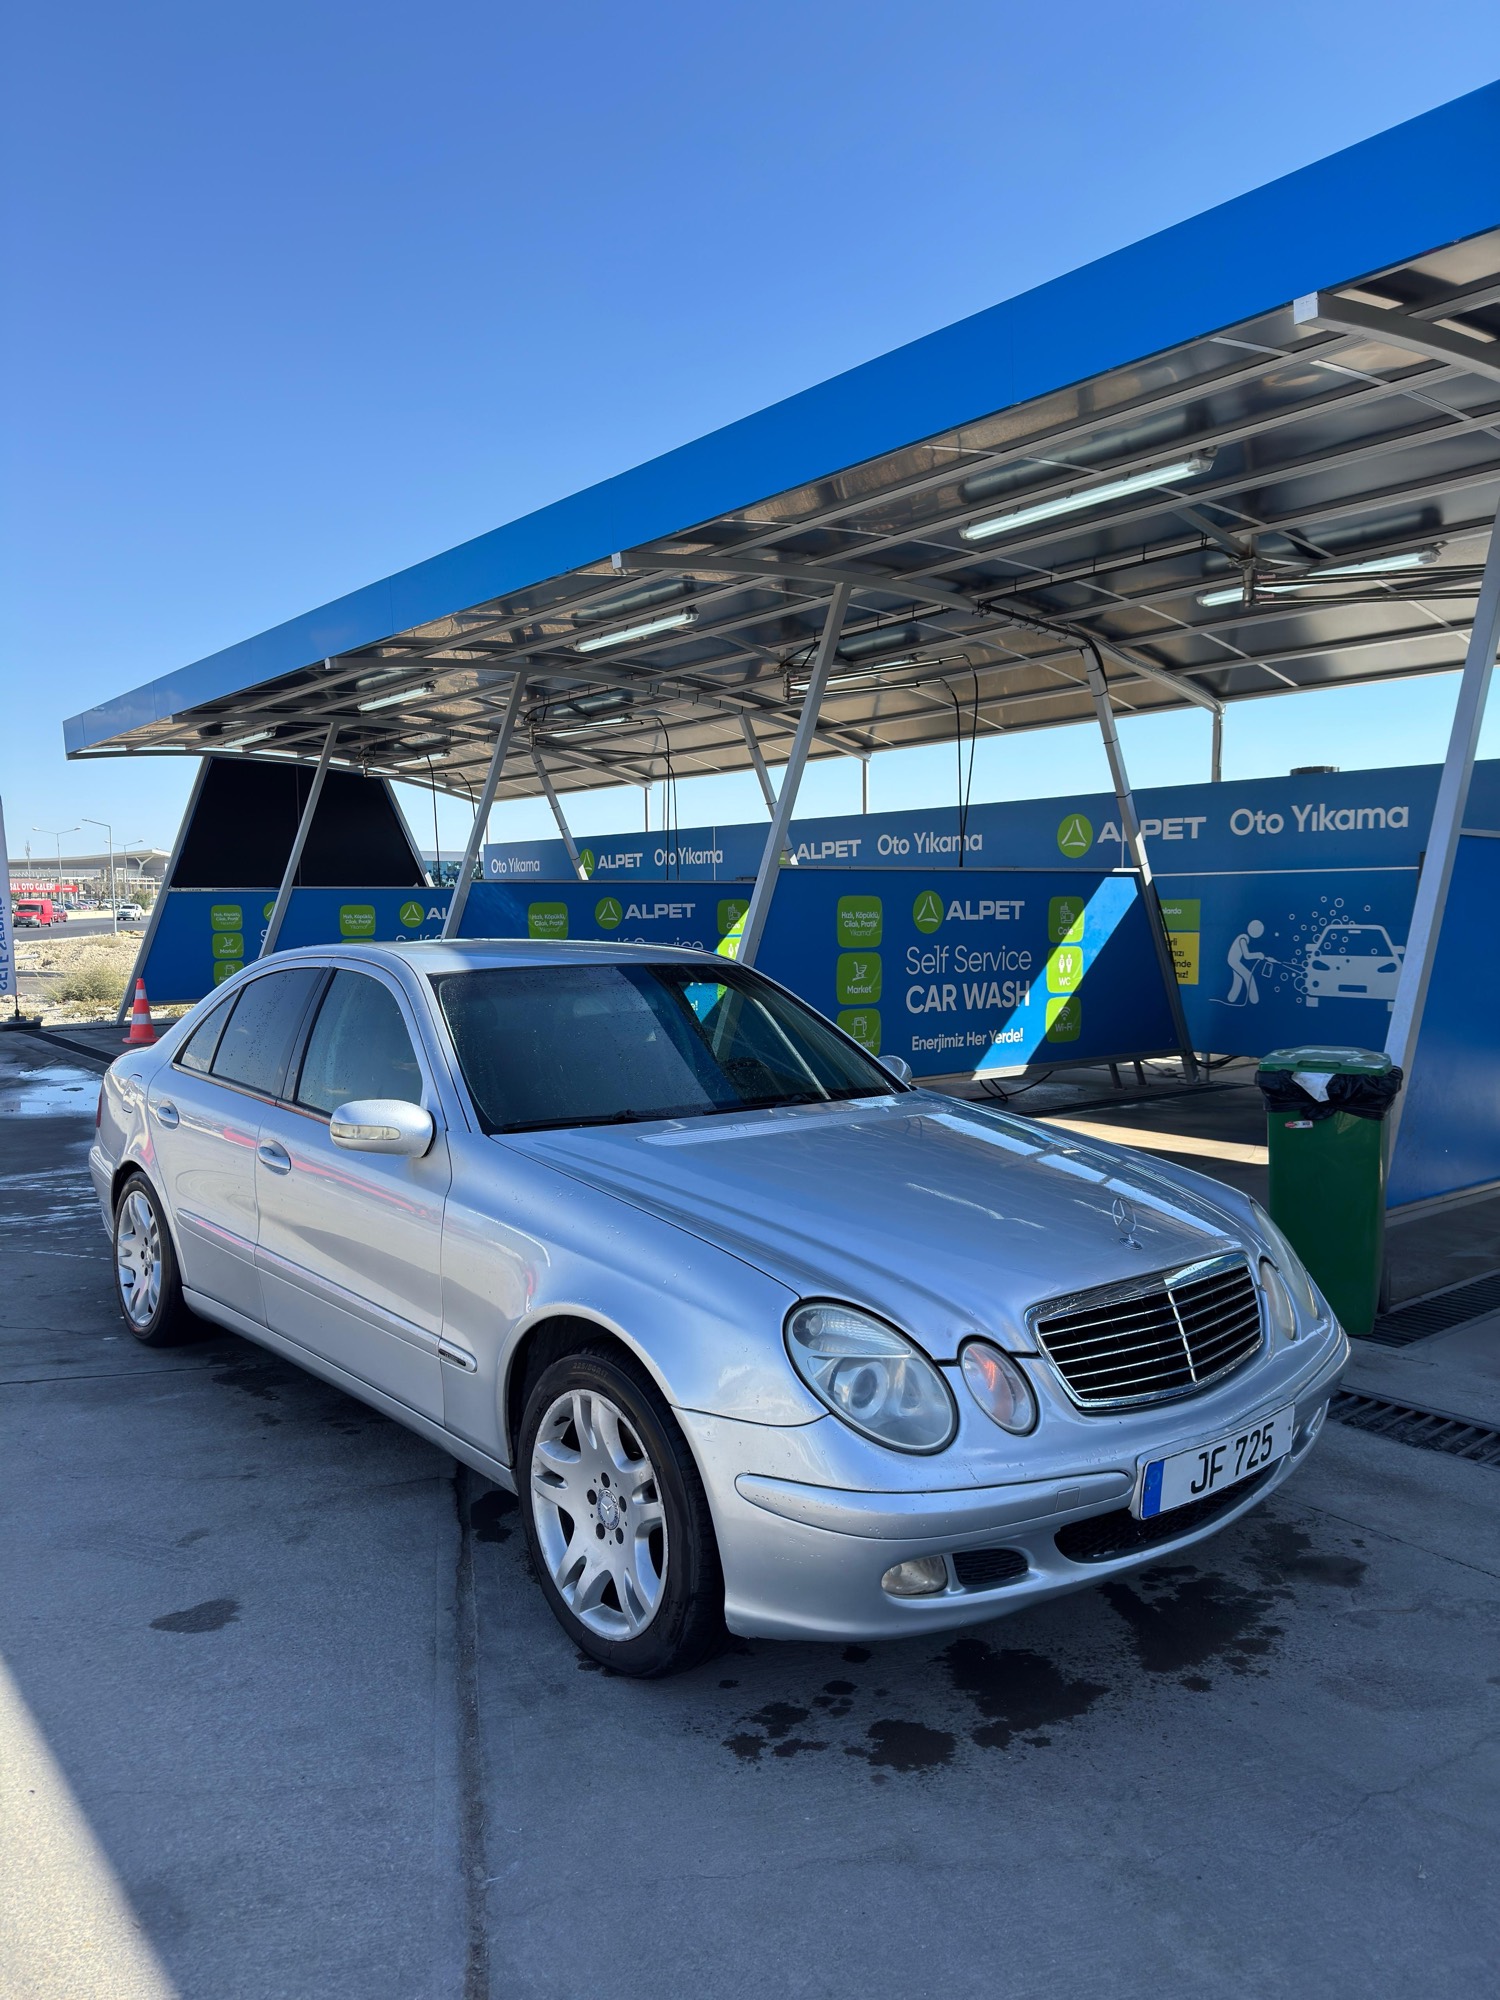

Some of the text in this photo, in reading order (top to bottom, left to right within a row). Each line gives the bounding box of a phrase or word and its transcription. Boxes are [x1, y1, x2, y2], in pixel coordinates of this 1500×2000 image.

[1229, 808, 1284, 836] Oto
[1290, 803, 1409, 833] Yıkama
[796, 831, 983, 860] ALPET Oto Yıkama
[490, 857, 540, 874] Oto Yıkama
[597, 847, 723, 869] ALPET Oto Yıkama
[21, 883, 34, 891] OTO
[625, 903, 696, 919] ALPET
[945, 900, 1025, 920] ALPET
[1057, 926, 1074, 936] Cafe
[905, 945, 1032, 975] Self Service
[847, 985, 872, 994] Market
[1059, 977, 1071, 987] WC
[905, 980, 1030, 1014] CAR WASH
[1055, 1023, 1073, 1032] Wi-Fi
[911, 1027, 1024, 1053] Enerjimiz Her Yerde!
[1190, 1421, 1275, 1495] JF 725
